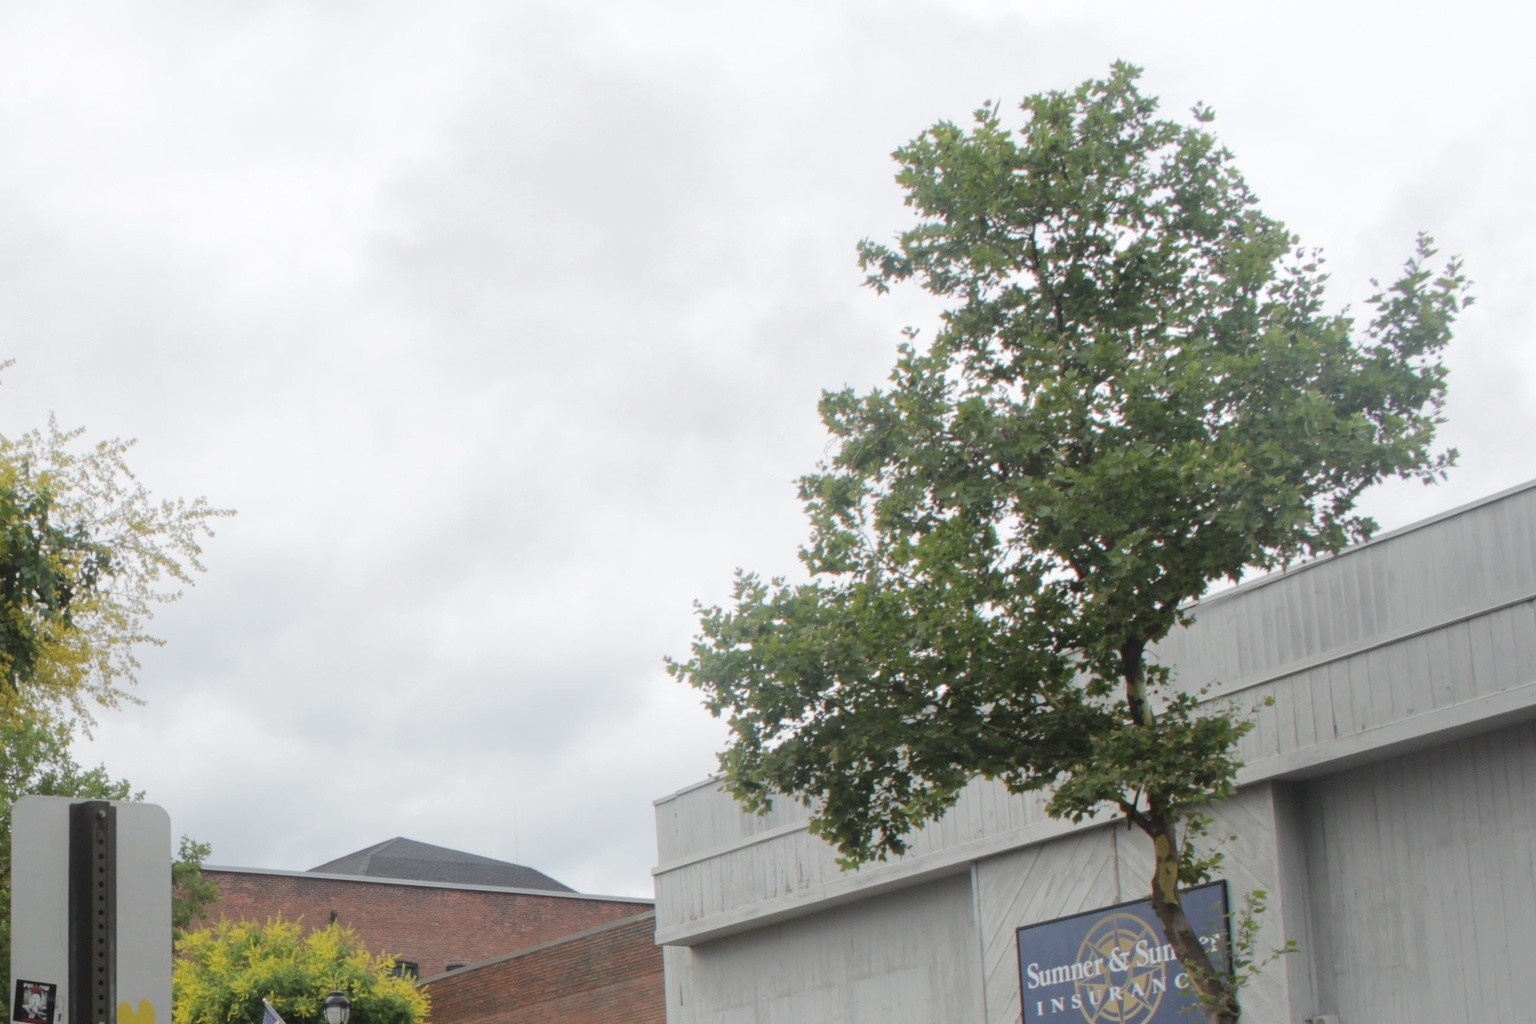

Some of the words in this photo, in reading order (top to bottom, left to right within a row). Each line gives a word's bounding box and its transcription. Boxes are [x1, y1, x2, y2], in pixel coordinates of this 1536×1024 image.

[1027, 958, 1104, 989] Sumner
[1109, 947, 1129, 972] &
[1135, 932, 1221, 967] Sumer
[1037, 973, 1189, 1016] INSURANC
